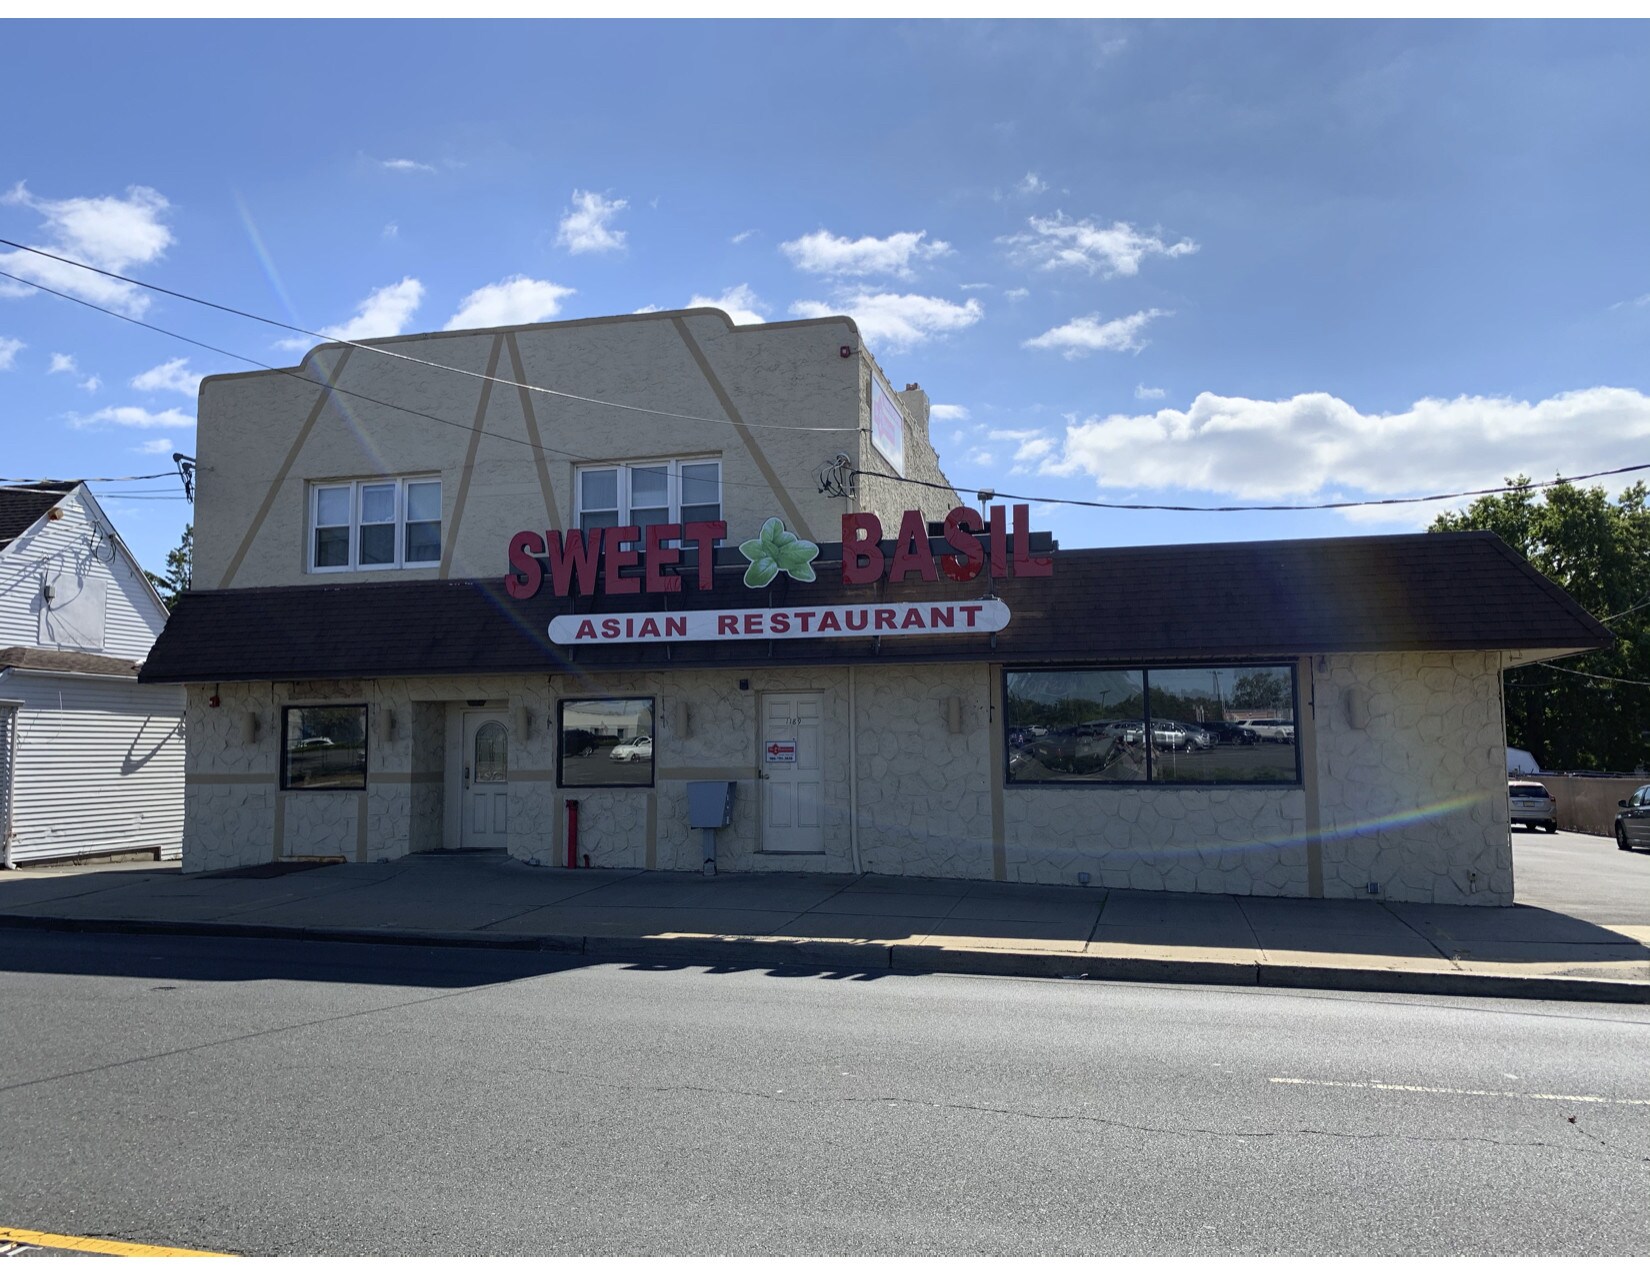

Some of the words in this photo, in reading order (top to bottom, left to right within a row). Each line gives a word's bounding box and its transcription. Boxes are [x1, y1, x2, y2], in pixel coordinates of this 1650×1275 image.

[505, 520, 727, 599] SWEET
[842, 504, 1053, 584] BASIL
[575, 616, 687, 640] ASIAN
[718, 605, 983, 635] RESTAURANT
